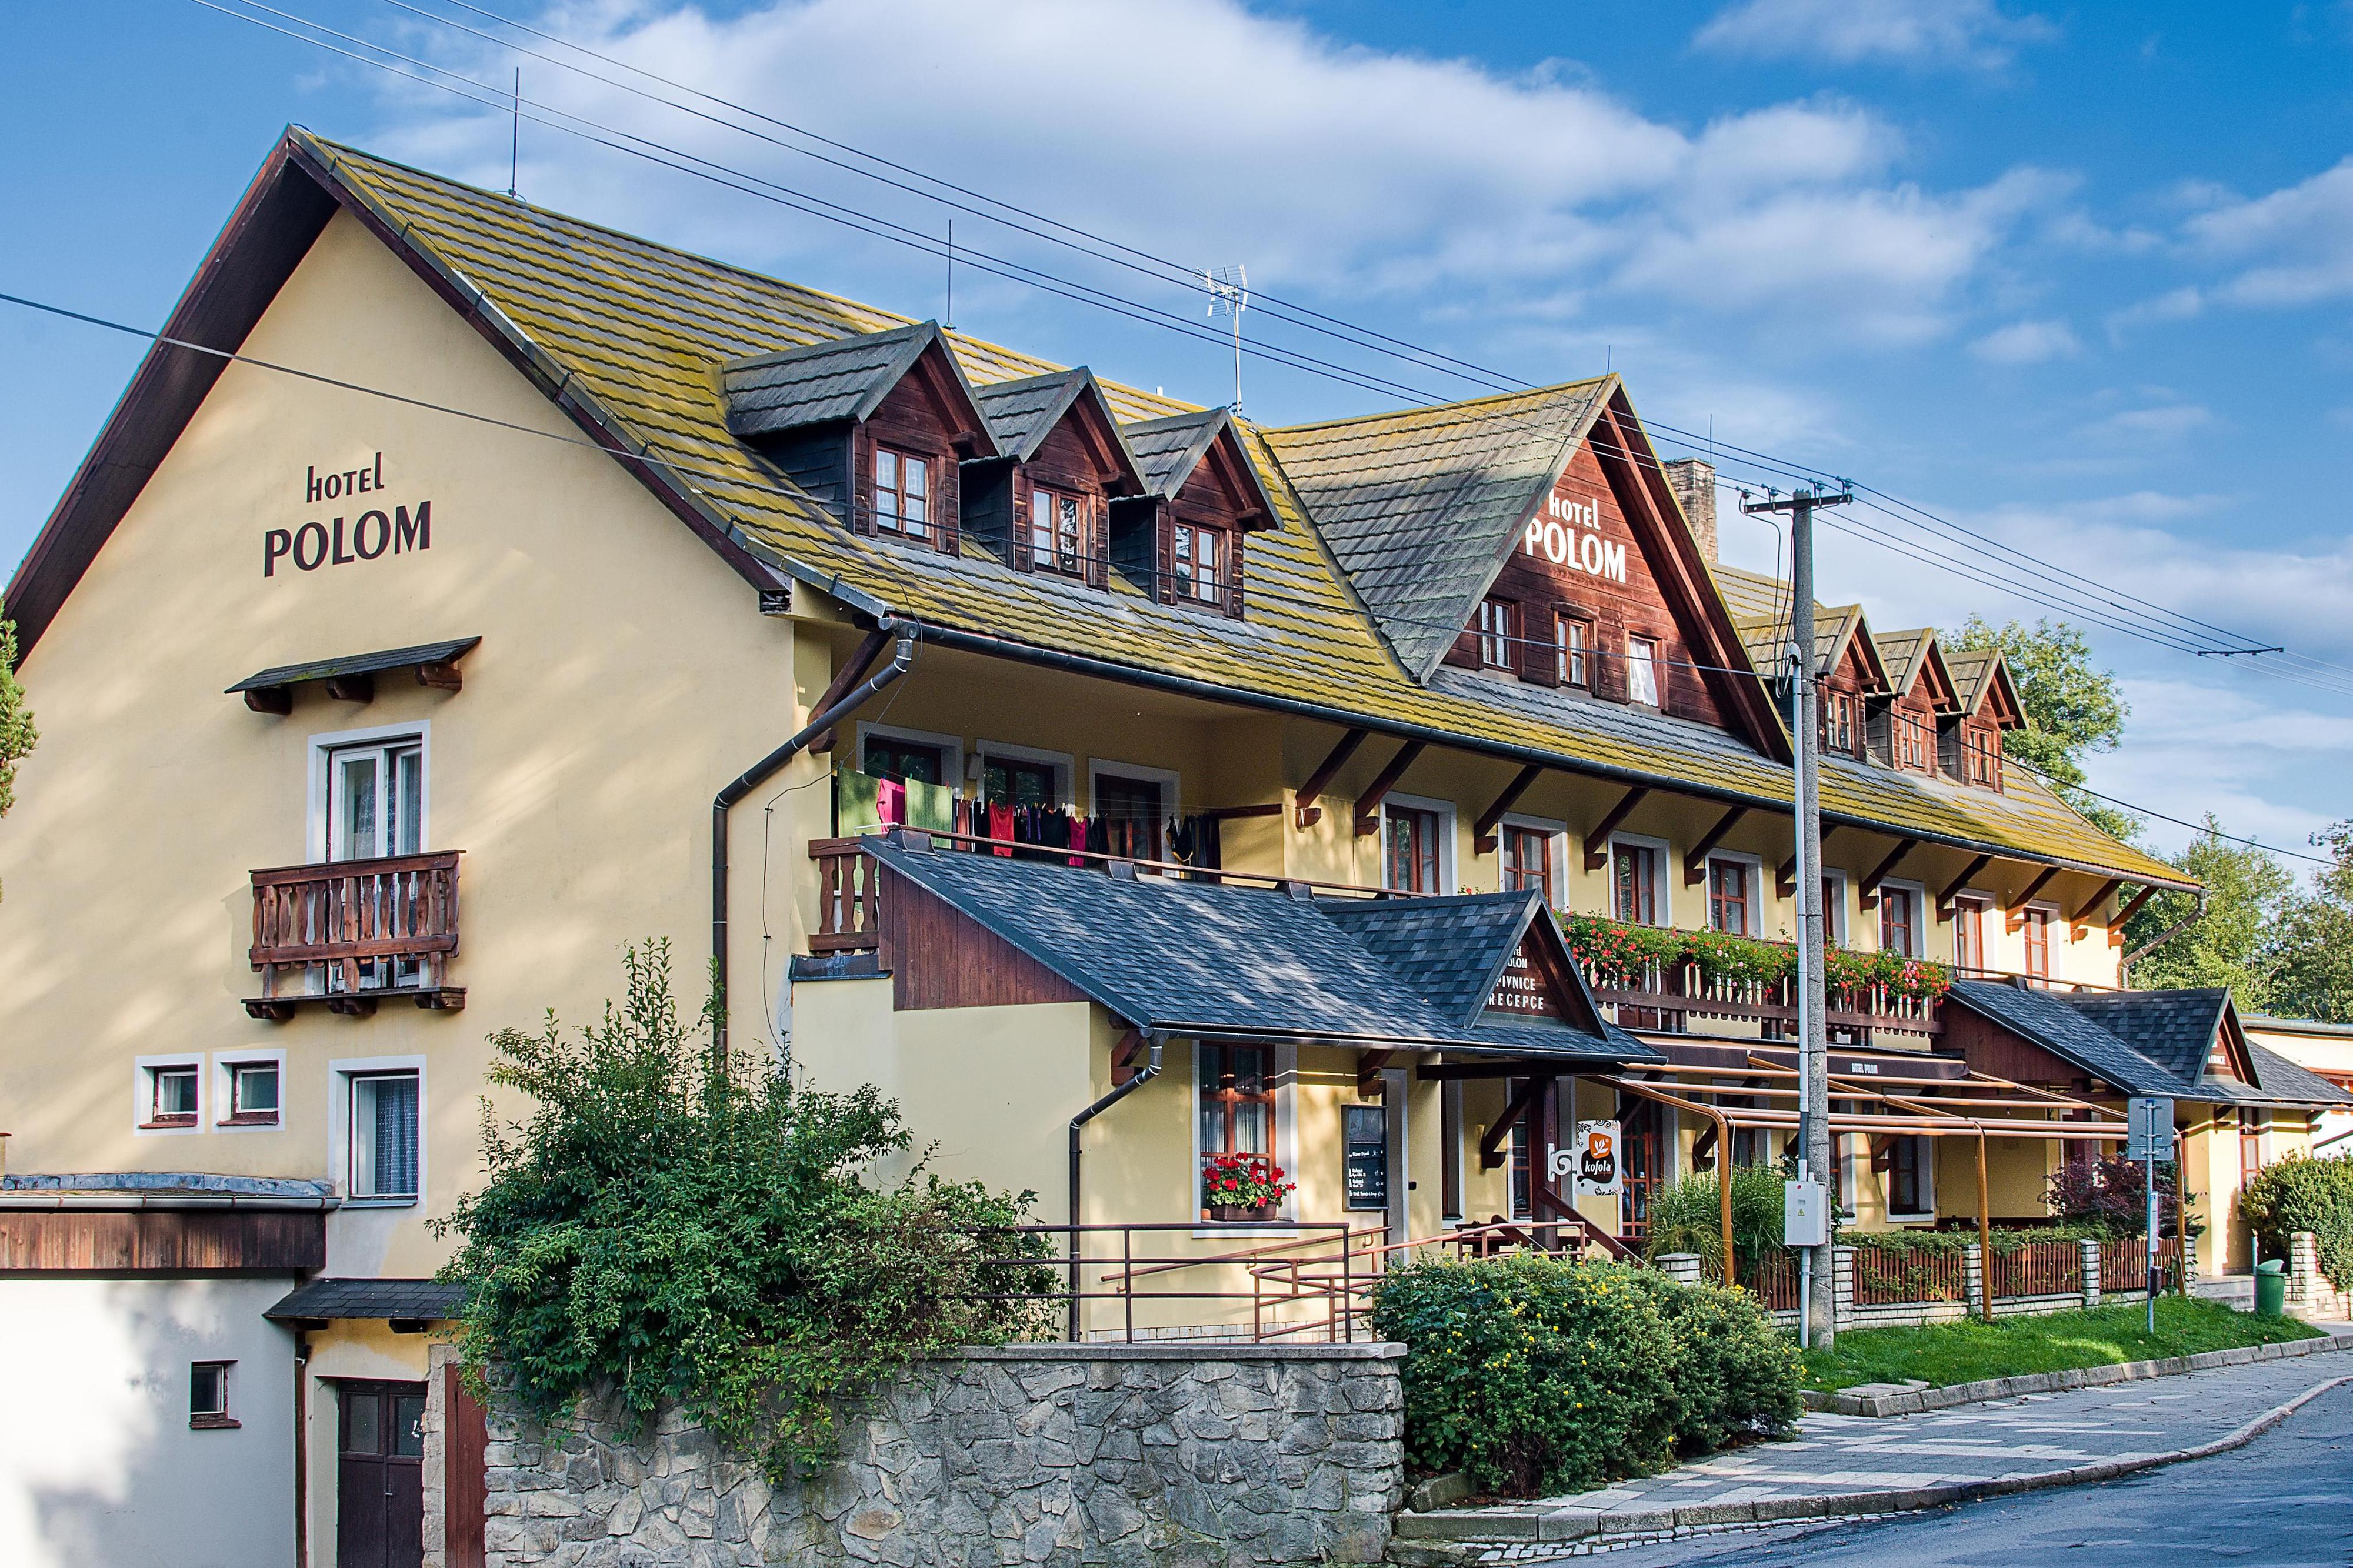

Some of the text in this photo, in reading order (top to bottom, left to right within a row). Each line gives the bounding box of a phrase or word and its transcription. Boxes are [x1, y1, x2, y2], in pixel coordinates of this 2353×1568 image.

[264, 501, 431, 578] POLOM
[1525, 517, 1627, 583] POLOM
[1488, 993, 1544, 1010] RECEPCE
[1585, 1160, 1611, 1175] kofola
